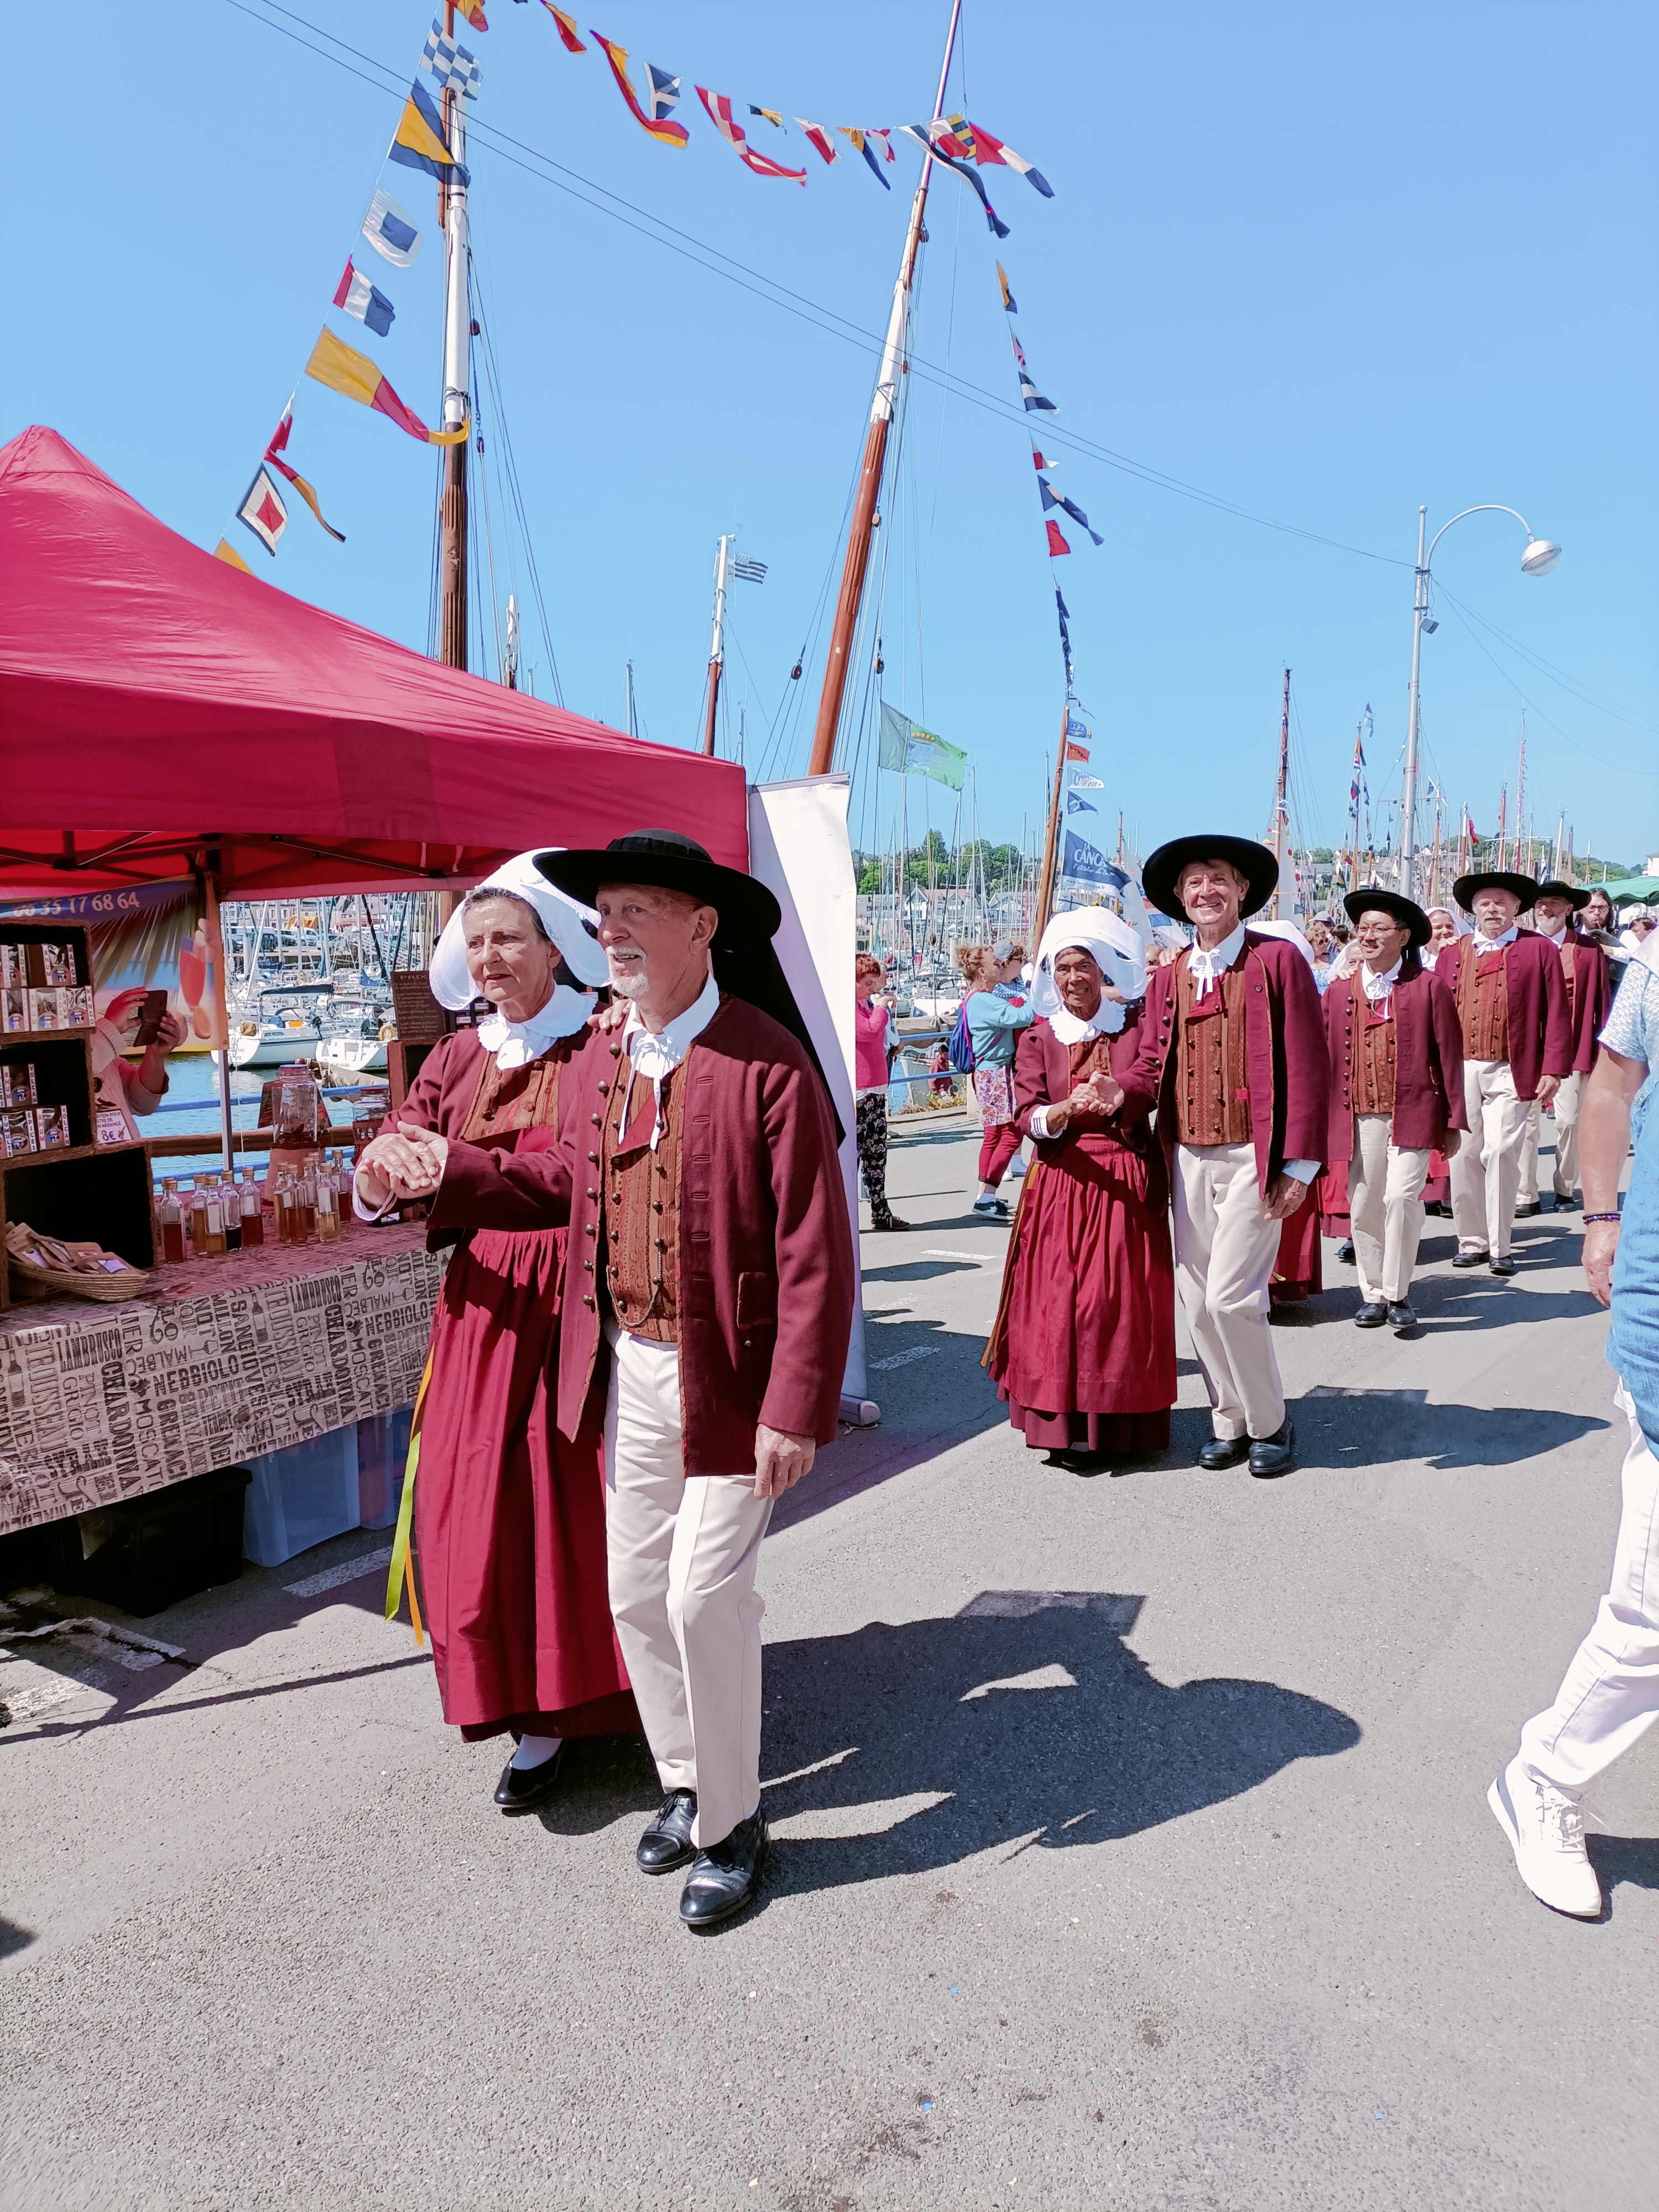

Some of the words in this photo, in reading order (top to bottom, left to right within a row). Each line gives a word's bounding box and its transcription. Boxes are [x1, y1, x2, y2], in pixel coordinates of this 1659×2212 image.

[40, 900, 62, 916] 35
[68, 896, 88, 913] 17
[92, 894, 114, 911] 68
[117, 891, 140, 909] 64
[86, 988, 95, 1025] MANGO
[3, 1116, 12, 1156] TUMULTE
[101, 1130, 116, 1141] 8€
[289, 1275, 342, 1313] LAMBRUSCO
[364, 1301, 427, 1337] NEBBIOLO
[56, 1328, 123, 1373] LAMBRUSCO
[296, 1317, 316, 1373] GRIGIO
[308, 1313, 327, 1367] PINOT
[126, 1345, 193, 1377] MALBEC
[153, 1354, 239, 1397] NEBBIOLO
[62, 1376, 84, 1441] GRIGIO
[79, 1372, 102, 1434] PINOT
[197, 1378, 244, 1412] PETIT
